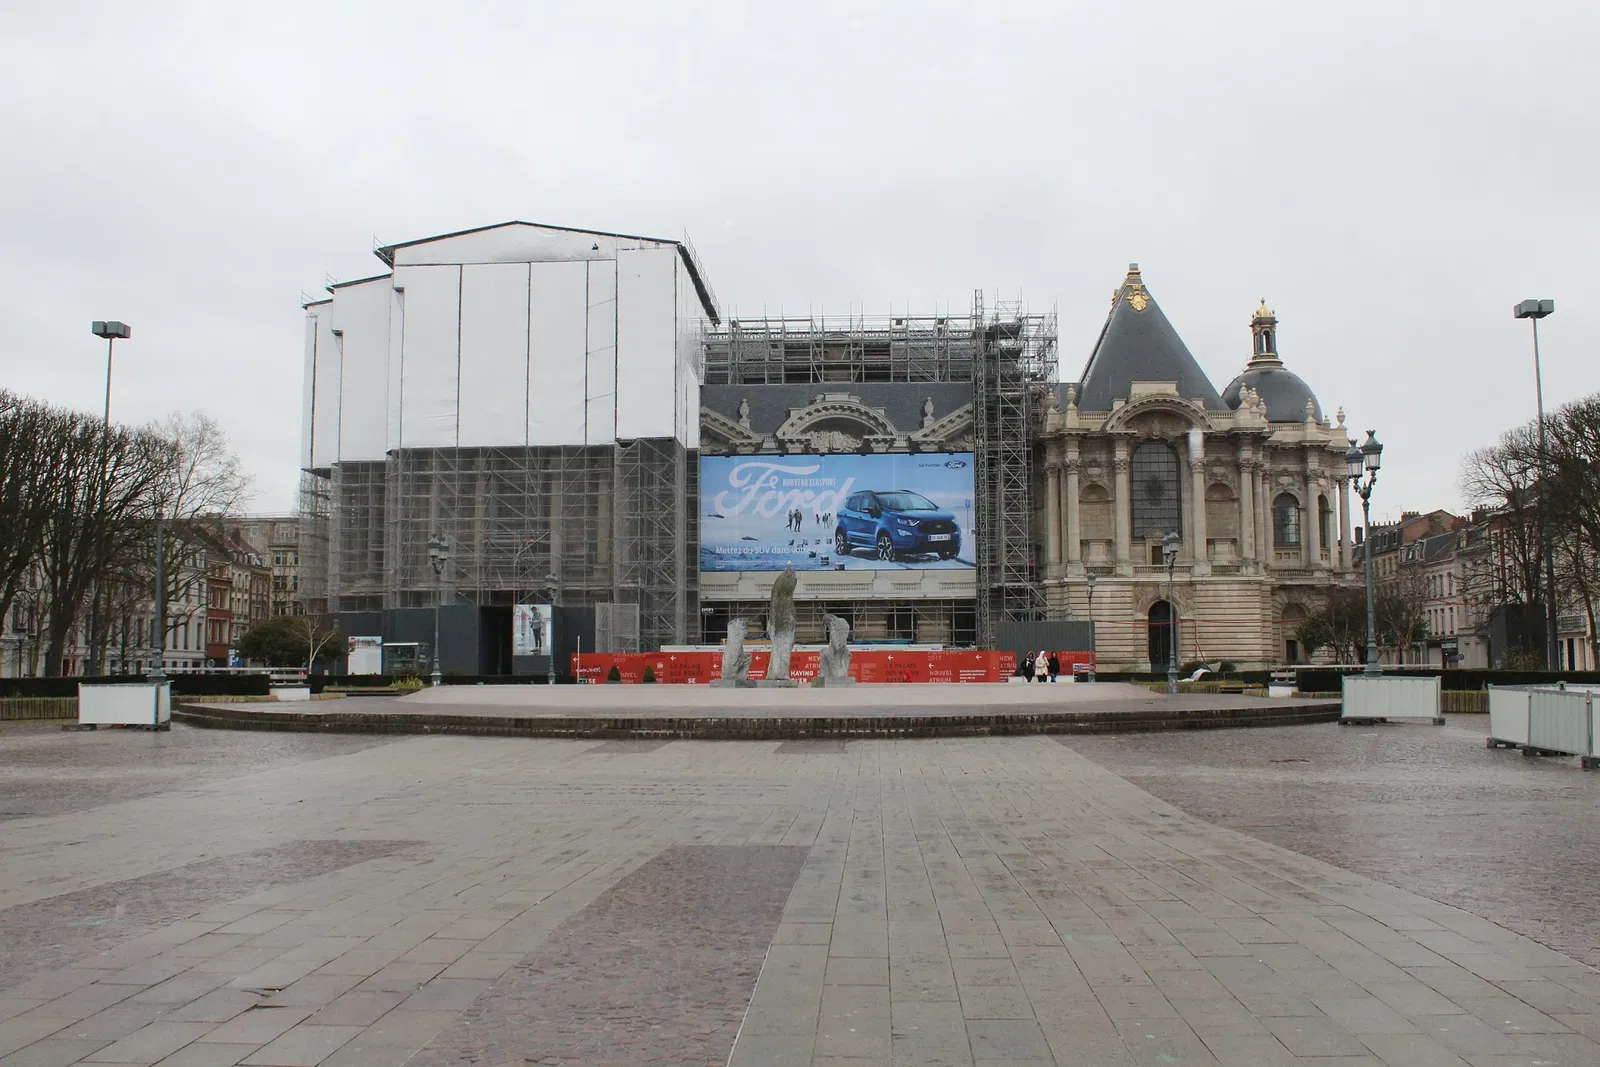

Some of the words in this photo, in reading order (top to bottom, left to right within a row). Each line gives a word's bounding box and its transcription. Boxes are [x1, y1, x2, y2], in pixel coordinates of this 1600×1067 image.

[782, 478, 808, 487] NOUVEAU
[809, 478, 836, 487] ECOSPORT
[714, 462, 855, 518] Ford
[715, 546, 742, 554] Mettez
[772, 546, 789, 554] dans
